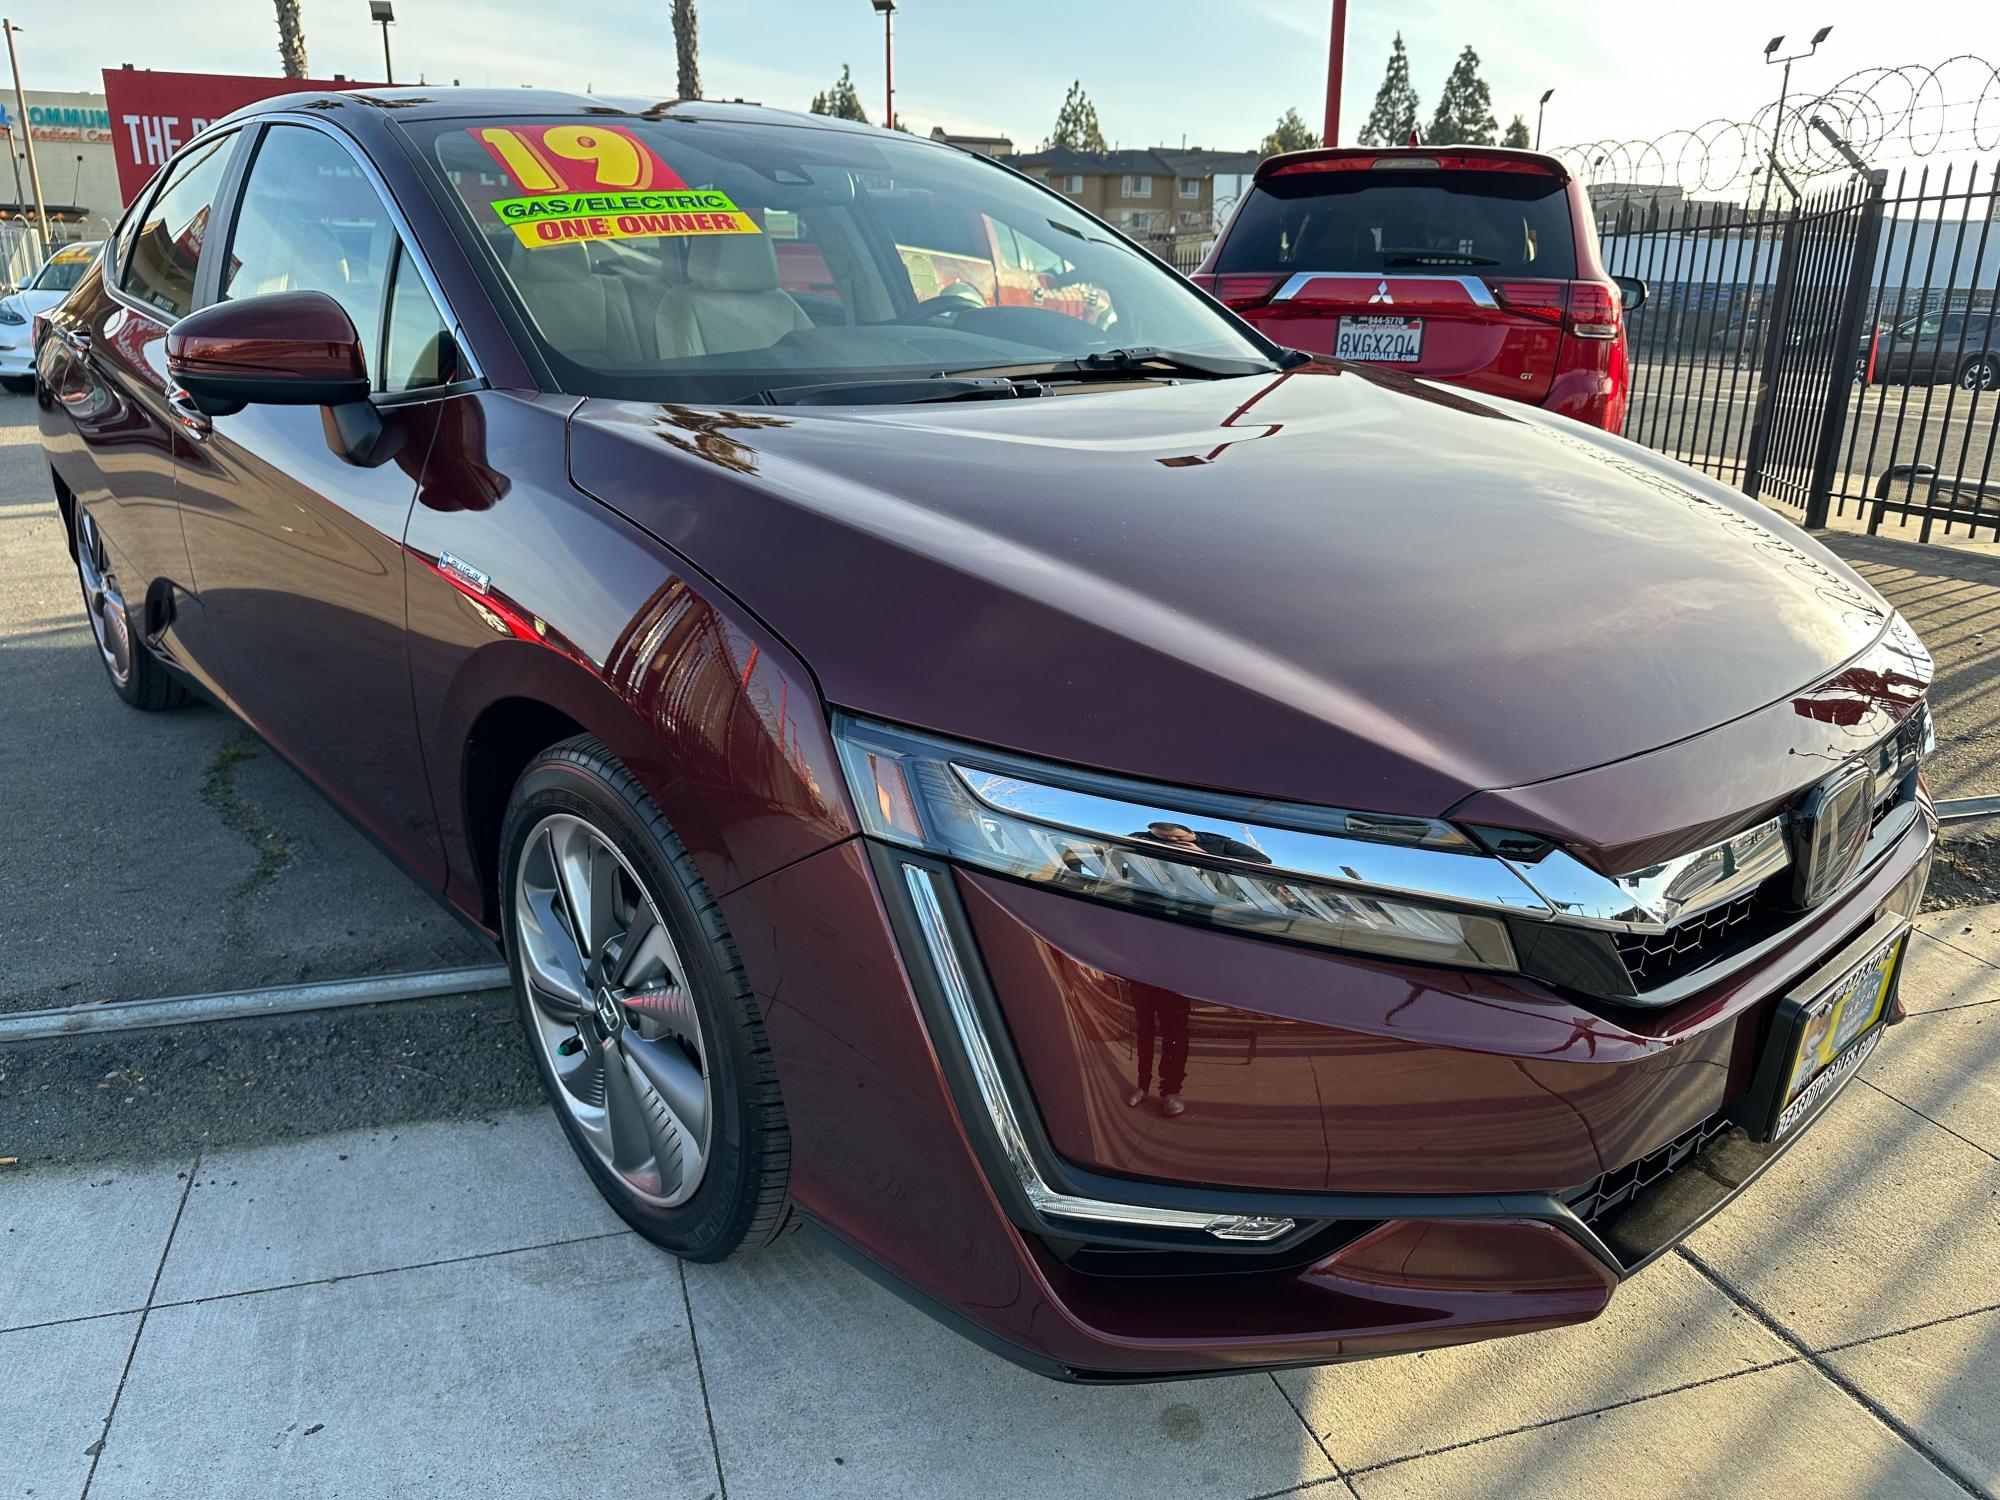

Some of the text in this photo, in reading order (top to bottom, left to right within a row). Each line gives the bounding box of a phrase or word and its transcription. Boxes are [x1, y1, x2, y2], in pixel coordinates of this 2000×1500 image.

[481, 125, 653, 192] 19
[503, 194, 729, 219] GAS/ELECTRIC
[536, 214, 740, 241] ONE OWNER
[1340, 333, 1416, 353] 8VGX204
